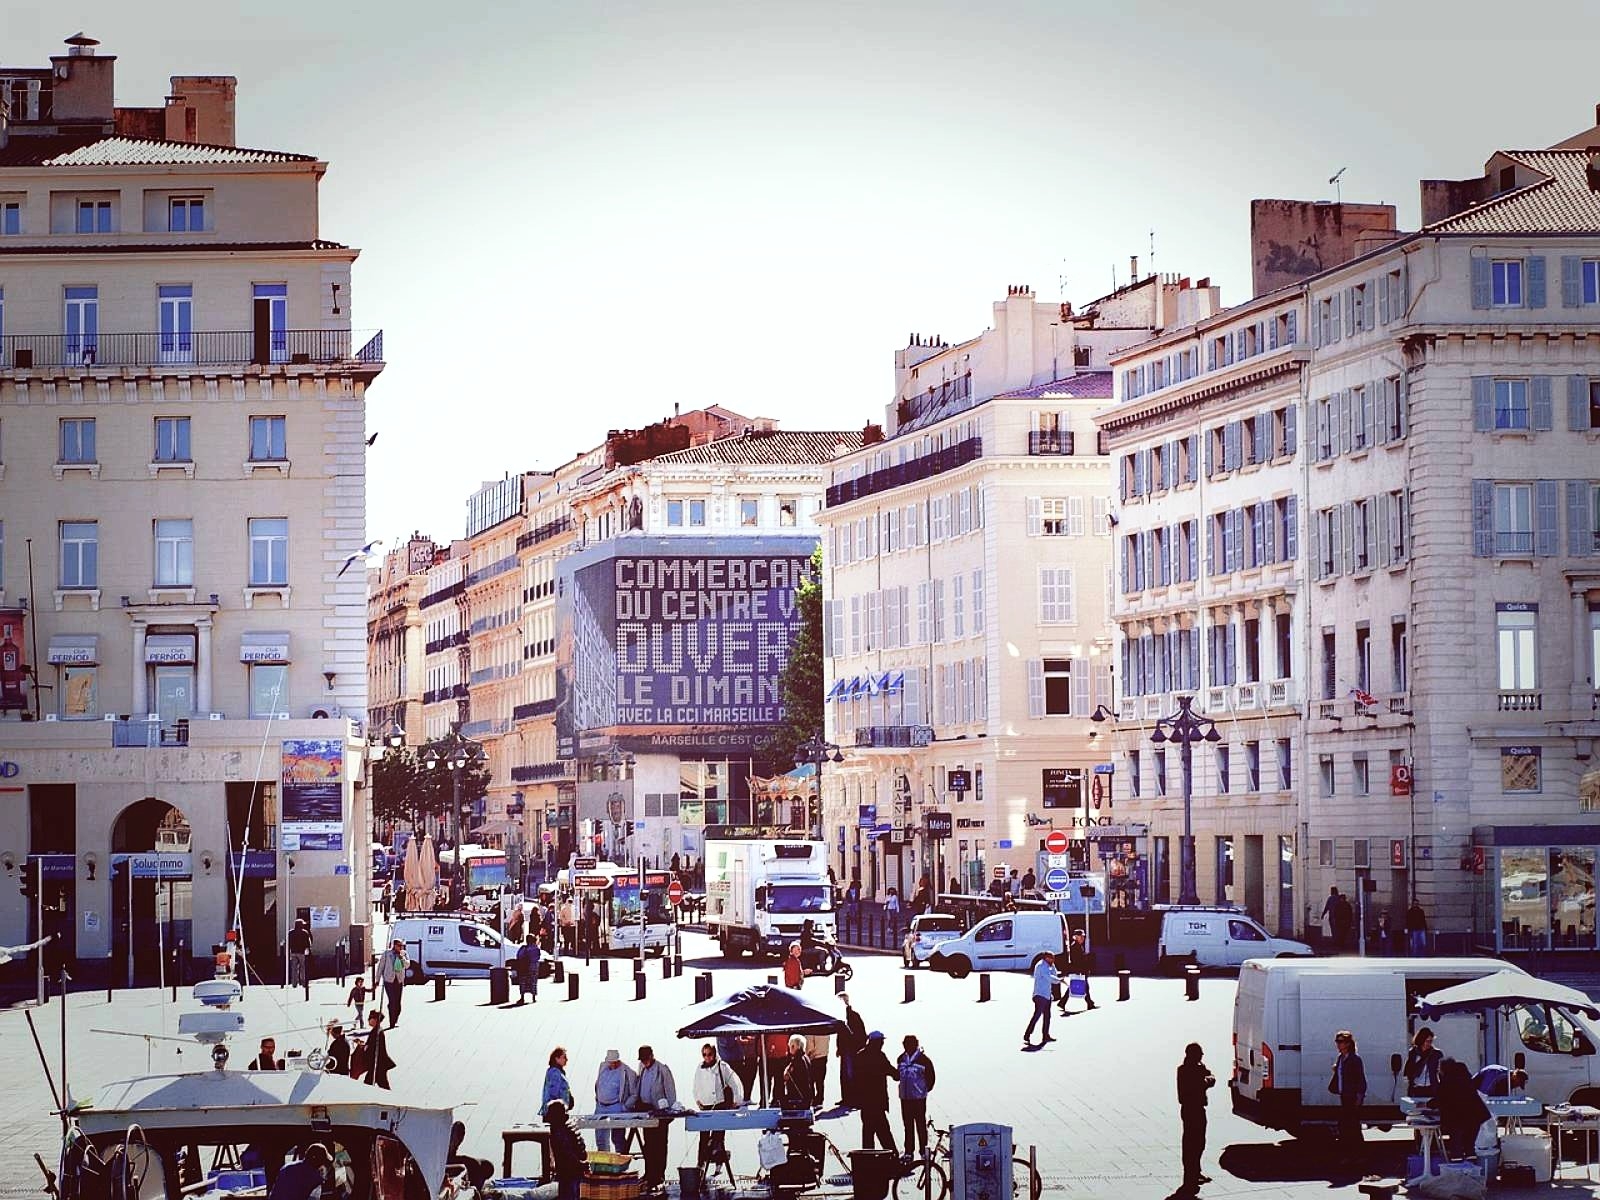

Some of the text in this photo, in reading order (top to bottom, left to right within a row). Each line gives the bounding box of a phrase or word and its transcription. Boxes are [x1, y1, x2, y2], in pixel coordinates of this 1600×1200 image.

[616, 590, 651, 620] DU
[661, 590, 768, 620] CENTRE
[617, 675, 654, 705] LE
[617, 707, 653, 723] AVEC
[657, 707, 673, 723] LA
[676, 707, 699, 723] CCI
[703, 707, 774, 723] MARSEILLE
[651, 736, 716, 746] MARSEILLE
[718, 736, 751, 745] C'EST
[1396, 767, 1409, 782] Q
[894, 766, 903, 841] CHANGE
[929, 819, 951, 830] Métro
[133, 858, 184, 869] Solucmmo
